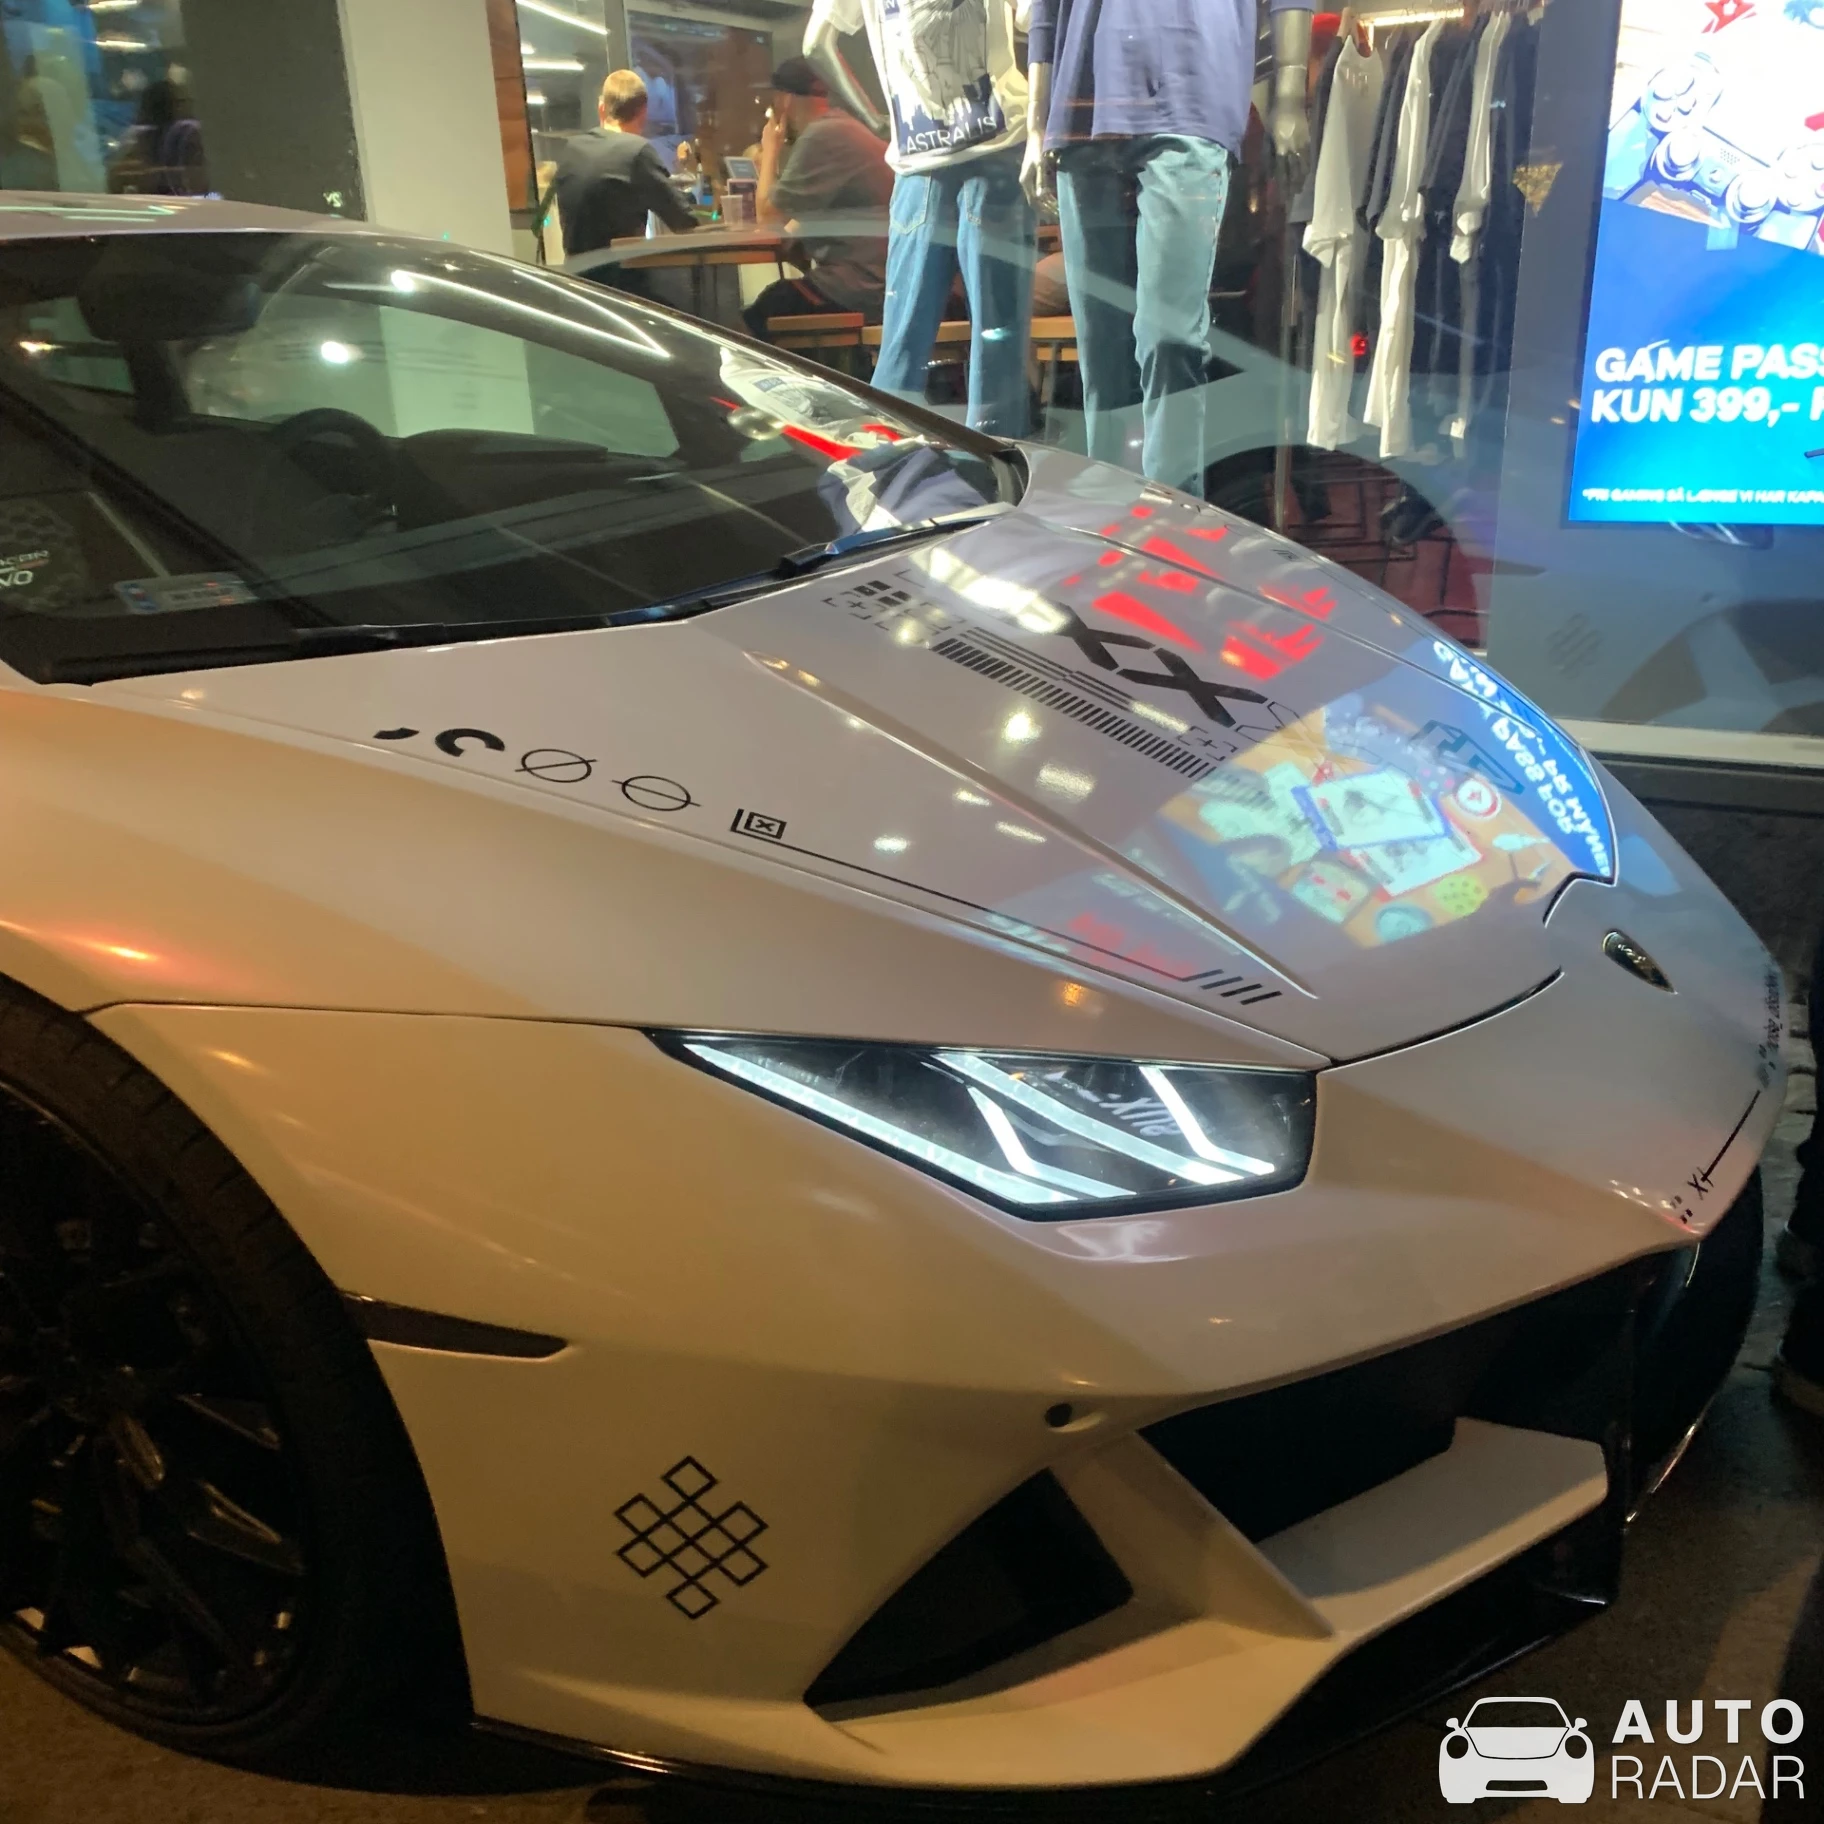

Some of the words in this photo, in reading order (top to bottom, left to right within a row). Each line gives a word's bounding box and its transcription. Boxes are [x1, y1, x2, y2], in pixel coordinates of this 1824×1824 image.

[906, 116, 997, 154] ASTRALIS
[1595, 345, 1724, 383] GAME
[1730, 342, 1824, 380] PAS
[1591, 387, 1683, 423] KUN
[1690, 386, 1800, 428] 399,-
